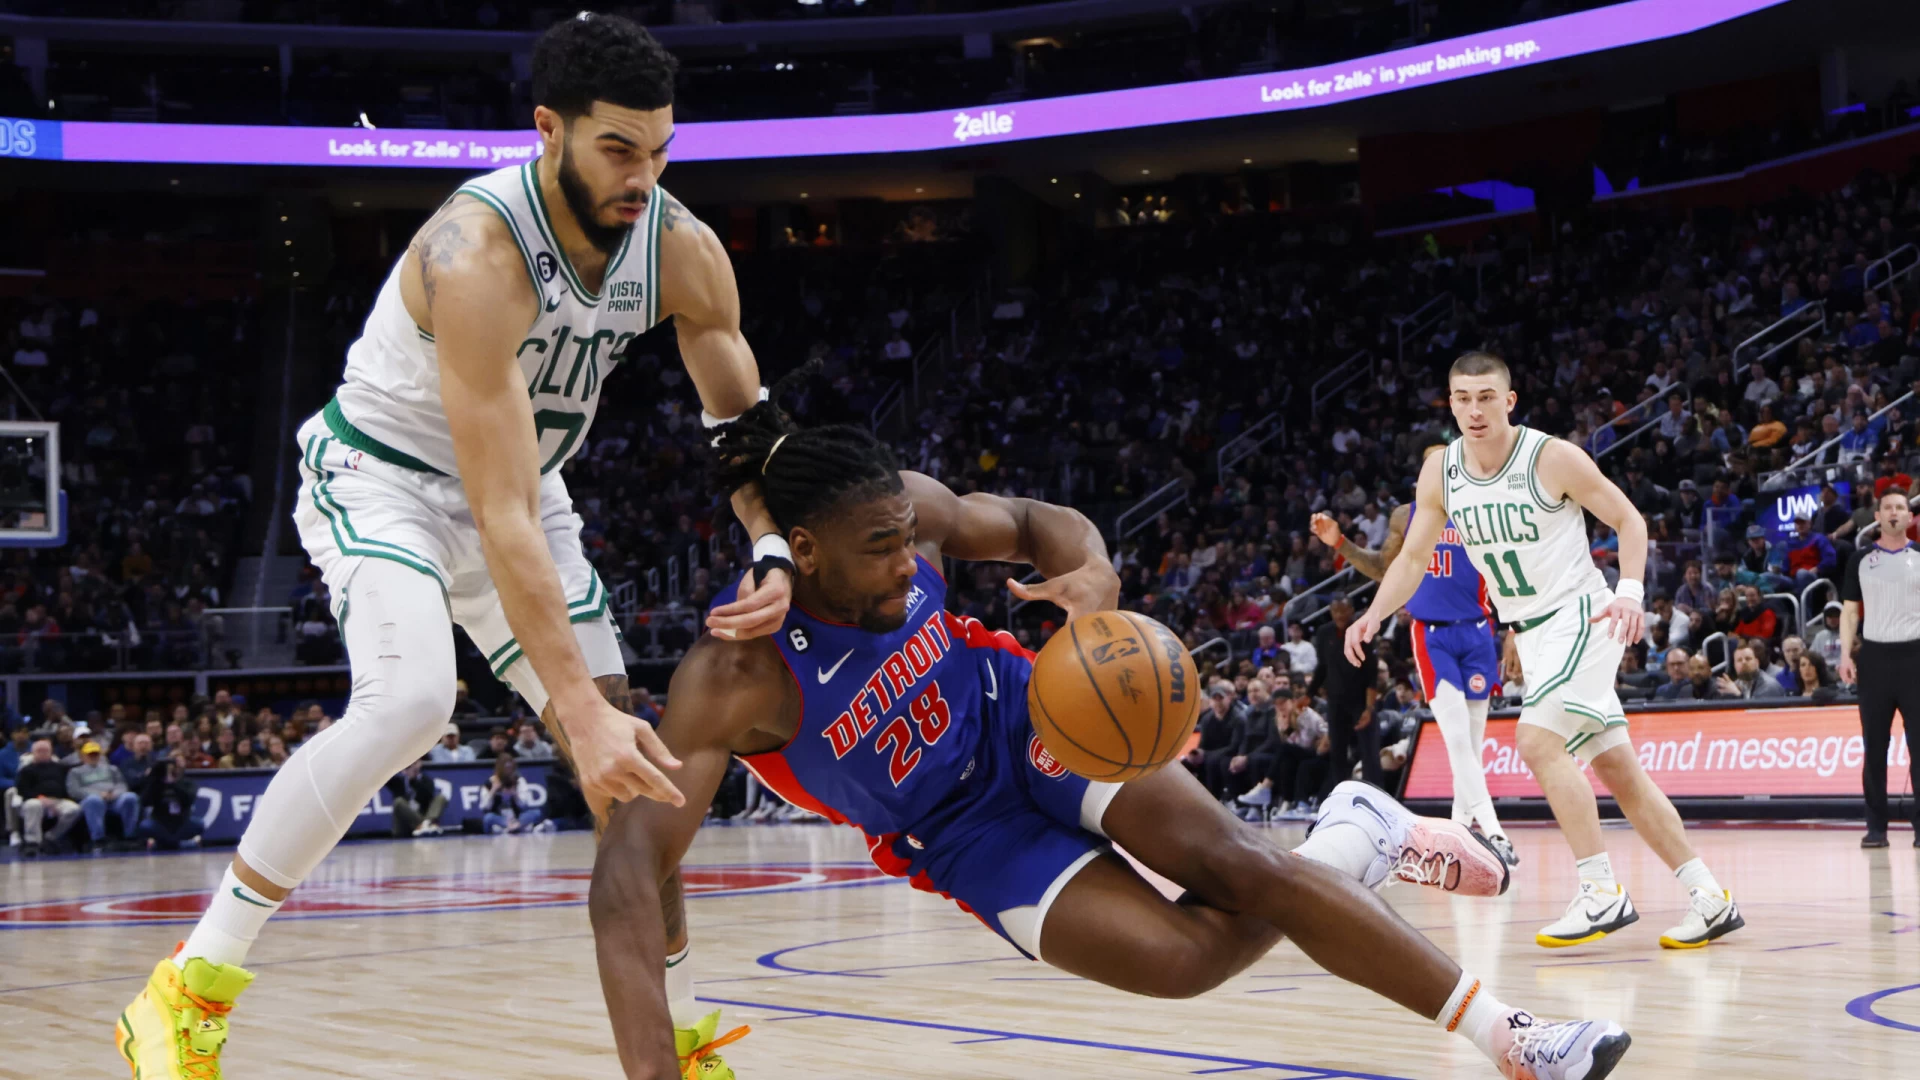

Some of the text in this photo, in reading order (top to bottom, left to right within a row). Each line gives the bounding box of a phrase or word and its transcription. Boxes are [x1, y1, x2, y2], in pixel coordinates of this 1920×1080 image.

[1261, 82, 1305, 102] Look
[1307, 79, 1332, 97] for
[1379, 65, 1395, 83] in
[1397, 60, 1434, 83] your
[1436, 46, 1502, 72] banking
[1504, 39, 1541, 59] app.
[329, 139, 377, 156] Look
[380, 140, 409, 157] for
[469, 142, 488, 158] in
[491, 144, 534, 163] your
[538, 253, 552, 283] 6
[609, 280, 643, 299] VISTA
[607, 299, 643, 313] PRINT
[1507, 473, 1526, 483] VISTA
[1508, 482, 1526, 491] PRINT
[1452, 502, 1540, 546] CELTICS
[1425, 550, 1452, 578] 41
[1483, 549, 1537, 597] 11
[789, 627, 809, 651] 6
[821, 610, 951, 760] DETROIT
[875, 679, 951, 788] 28
[1638, 731, 1702, 772] and
